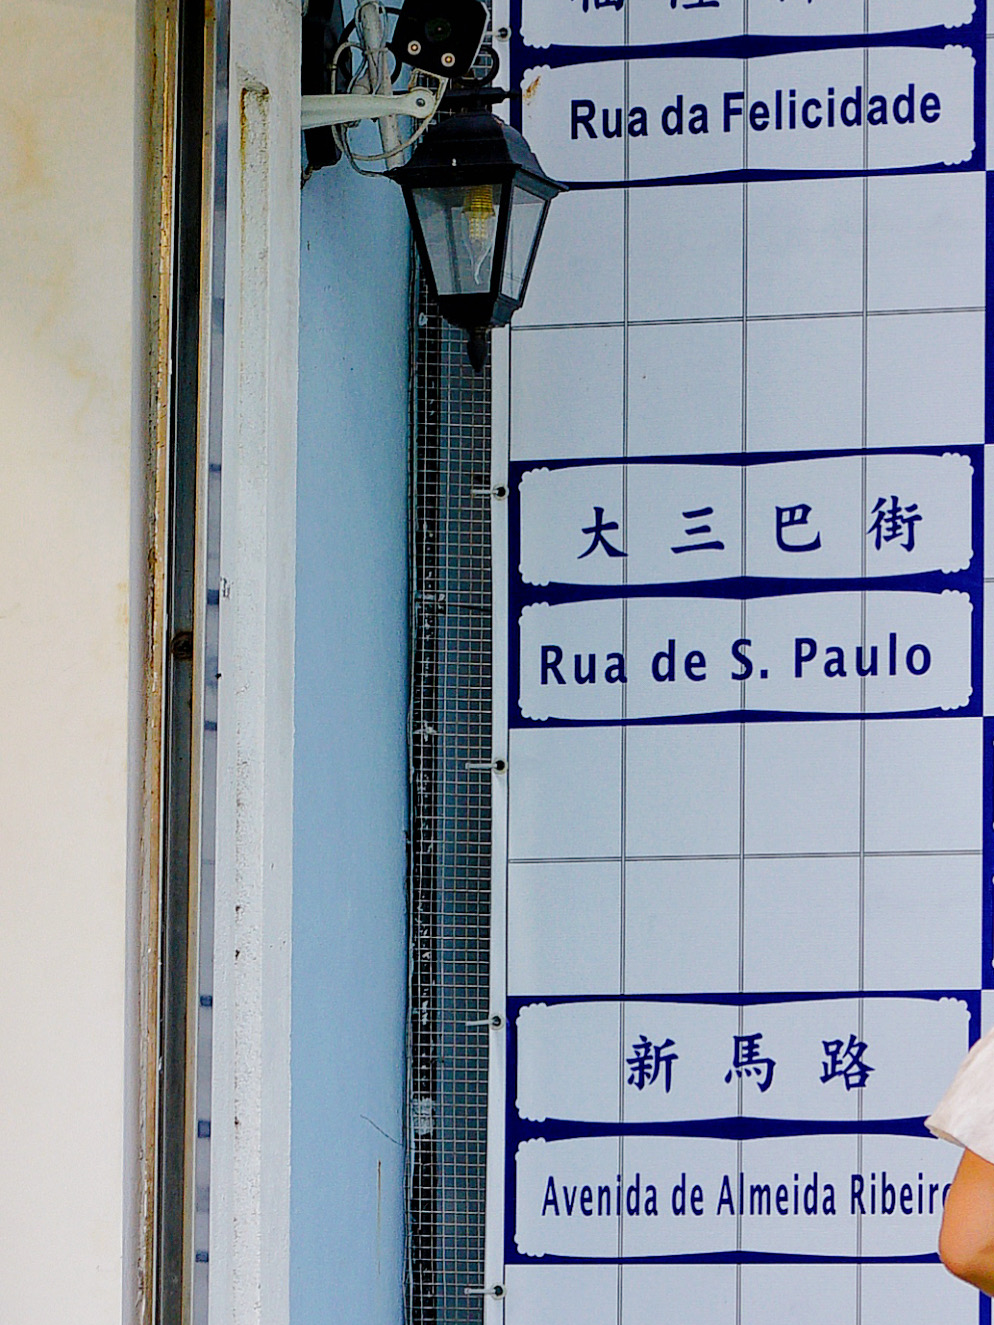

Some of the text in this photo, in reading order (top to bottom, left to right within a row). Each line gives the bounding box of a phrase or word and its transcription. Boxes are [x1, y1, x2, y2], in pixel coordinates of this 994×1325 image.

[570, 82, 942, 140] Rua da Felicidade
[576, 494, 924, 560] 大三巴街
[540, 631, 933, 685] Rua de S. Paulo
[625, 1032, 876, 1094] 新馬路
[541, 1171, 659, 1217] Avenida
[671, 1172, 704, 1216] de
[716, 1171, 837, 1216] Almeida
